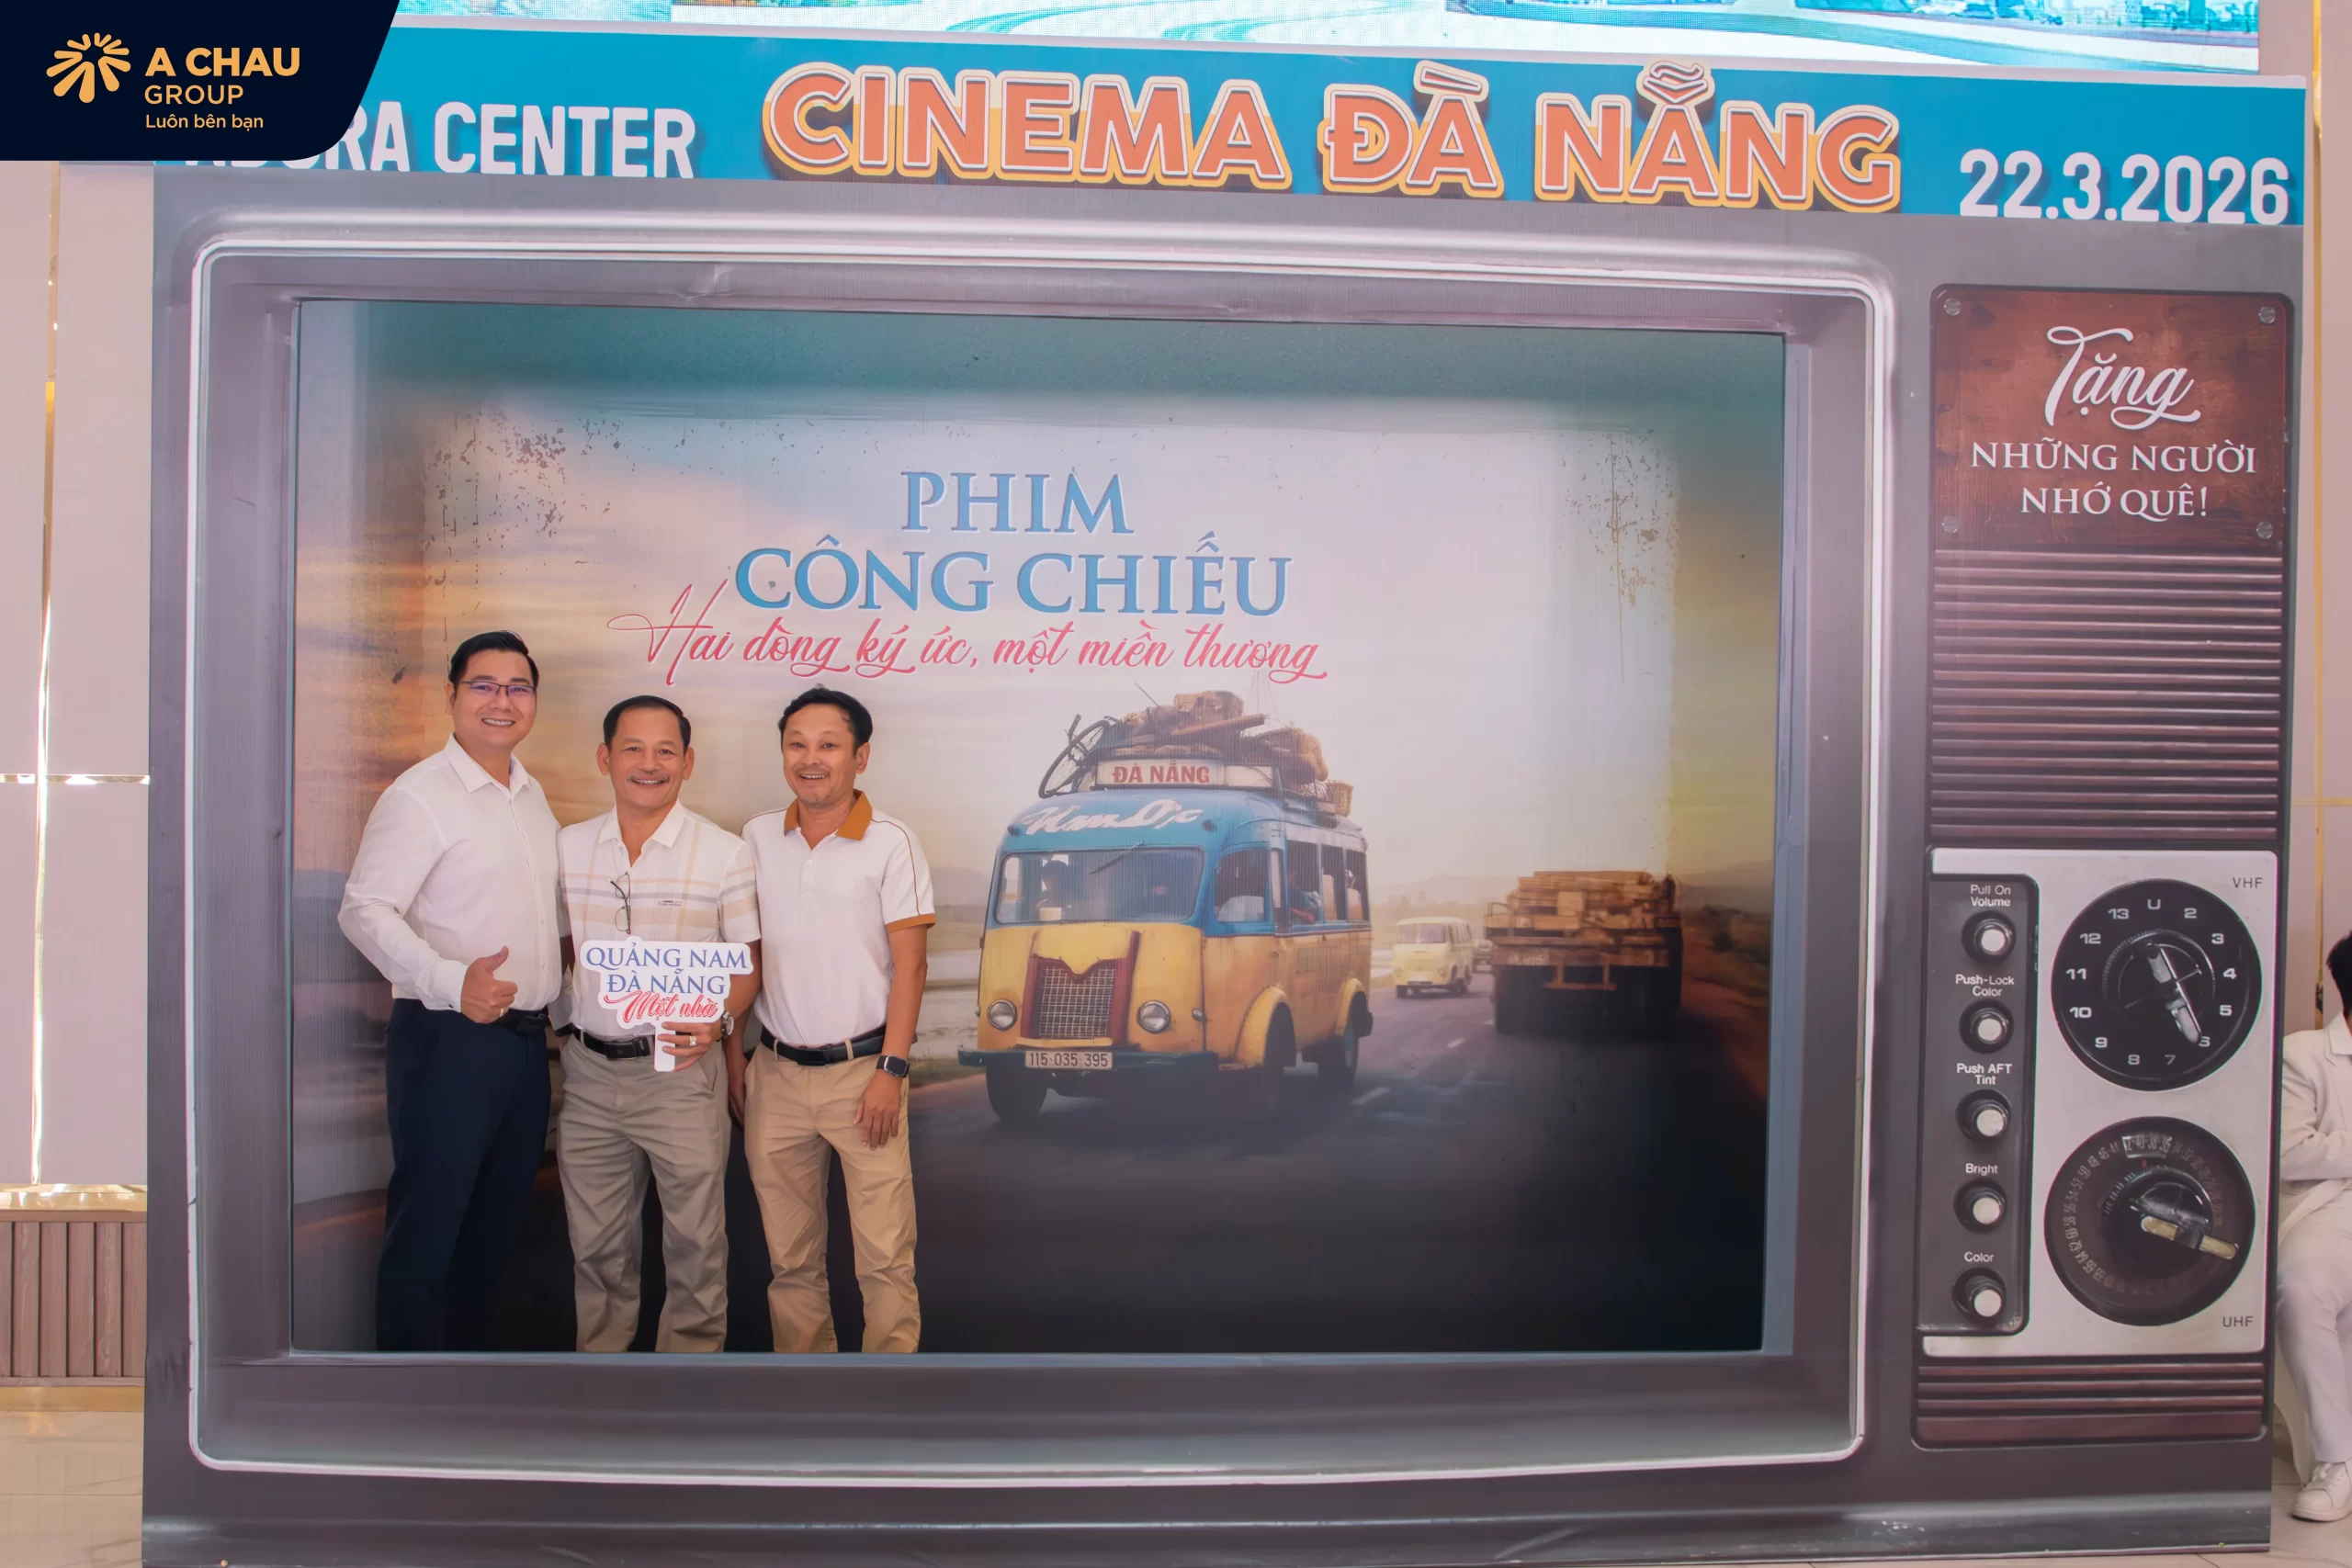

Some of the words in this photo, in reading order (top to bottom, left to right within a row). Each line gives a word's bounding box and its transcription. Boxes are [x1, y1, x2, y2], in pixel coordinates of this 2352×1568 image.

[434, 101, 696, 179] CENTER
[763, 62, 1291, 188] CINEMA
[1318, 61, 1504, 197] ĐÀ
[1535, 60, 1900, 212] NẴNG
[1959, 149, 2290, 226] 22.3.2026
[2043, 325, 2201, 431] Tặng
[1971, 437, 2119, 471] NHỮNG
[2131, 439, 2256, 474] NGƯỜI
[900, 471, 1135, 535] PHIM
[2020, 481, 2112, 515] NHỚ
[2120, 483, 2208, 523] QUÊ!
[734, 535, 994, 612] CÔNG
[1016, 531, 1293, 616] CHIẾU
[606, 579, 734, 686] Hai
[742, 616, 851, 678] dòng
[855, 617, 916, 678] ký
[920, 625, 978, 668] ức,
[992, 621, 1075, 673] một
[1078, 620, 1175, 668] miền
[1183, 624, 1328, 684] thương
[2233, 877, 2264, 889] VHF
[1970, 884, 1991, 895] Pull
[1994, 885, 2012, 896] On
[1970, 897, 2012, 908] Volume
[2108, 908, 2130, 919] 13
[2184, 908, 2198, 919] 2
[2079, 932, 2102, 944] 12
[2211, 933, 2224, 944] 3
[586, 942, 683, 971] QUẢNG
[689, 949, 749, 969] NAM
[2065, 967, 2086, 980] 11
[2222, 967, 2237, 979] 4
[606, 970, 641, 993] ĐÀ
[650, 968, 726, 995] NẴNG
[1954, 974, 2015, 986] Push-Lock
[1972, 985, 2003, 997] Color
[603, 990, 680, 1023] Một
[679, 994, 719, 1018] nhà
[2219, 1004, 2233, 1016] 5
[2069, 1007, 2092, 1019] 10
[2095, 1036, 2108, 1048] 9
[2165, 1054, 2176, 1066] 7
[1956, 1063, 1984, 1074] Push
[1987, 1063, 2013, 1074] AFT
[1974, 1075, 1996, 1085] Tint
[1964, 1163, 1998, 1177] Bright
[1963, 1251, 1995, 1263] Color
[2222, 1315, 2254, 1327] UHF
